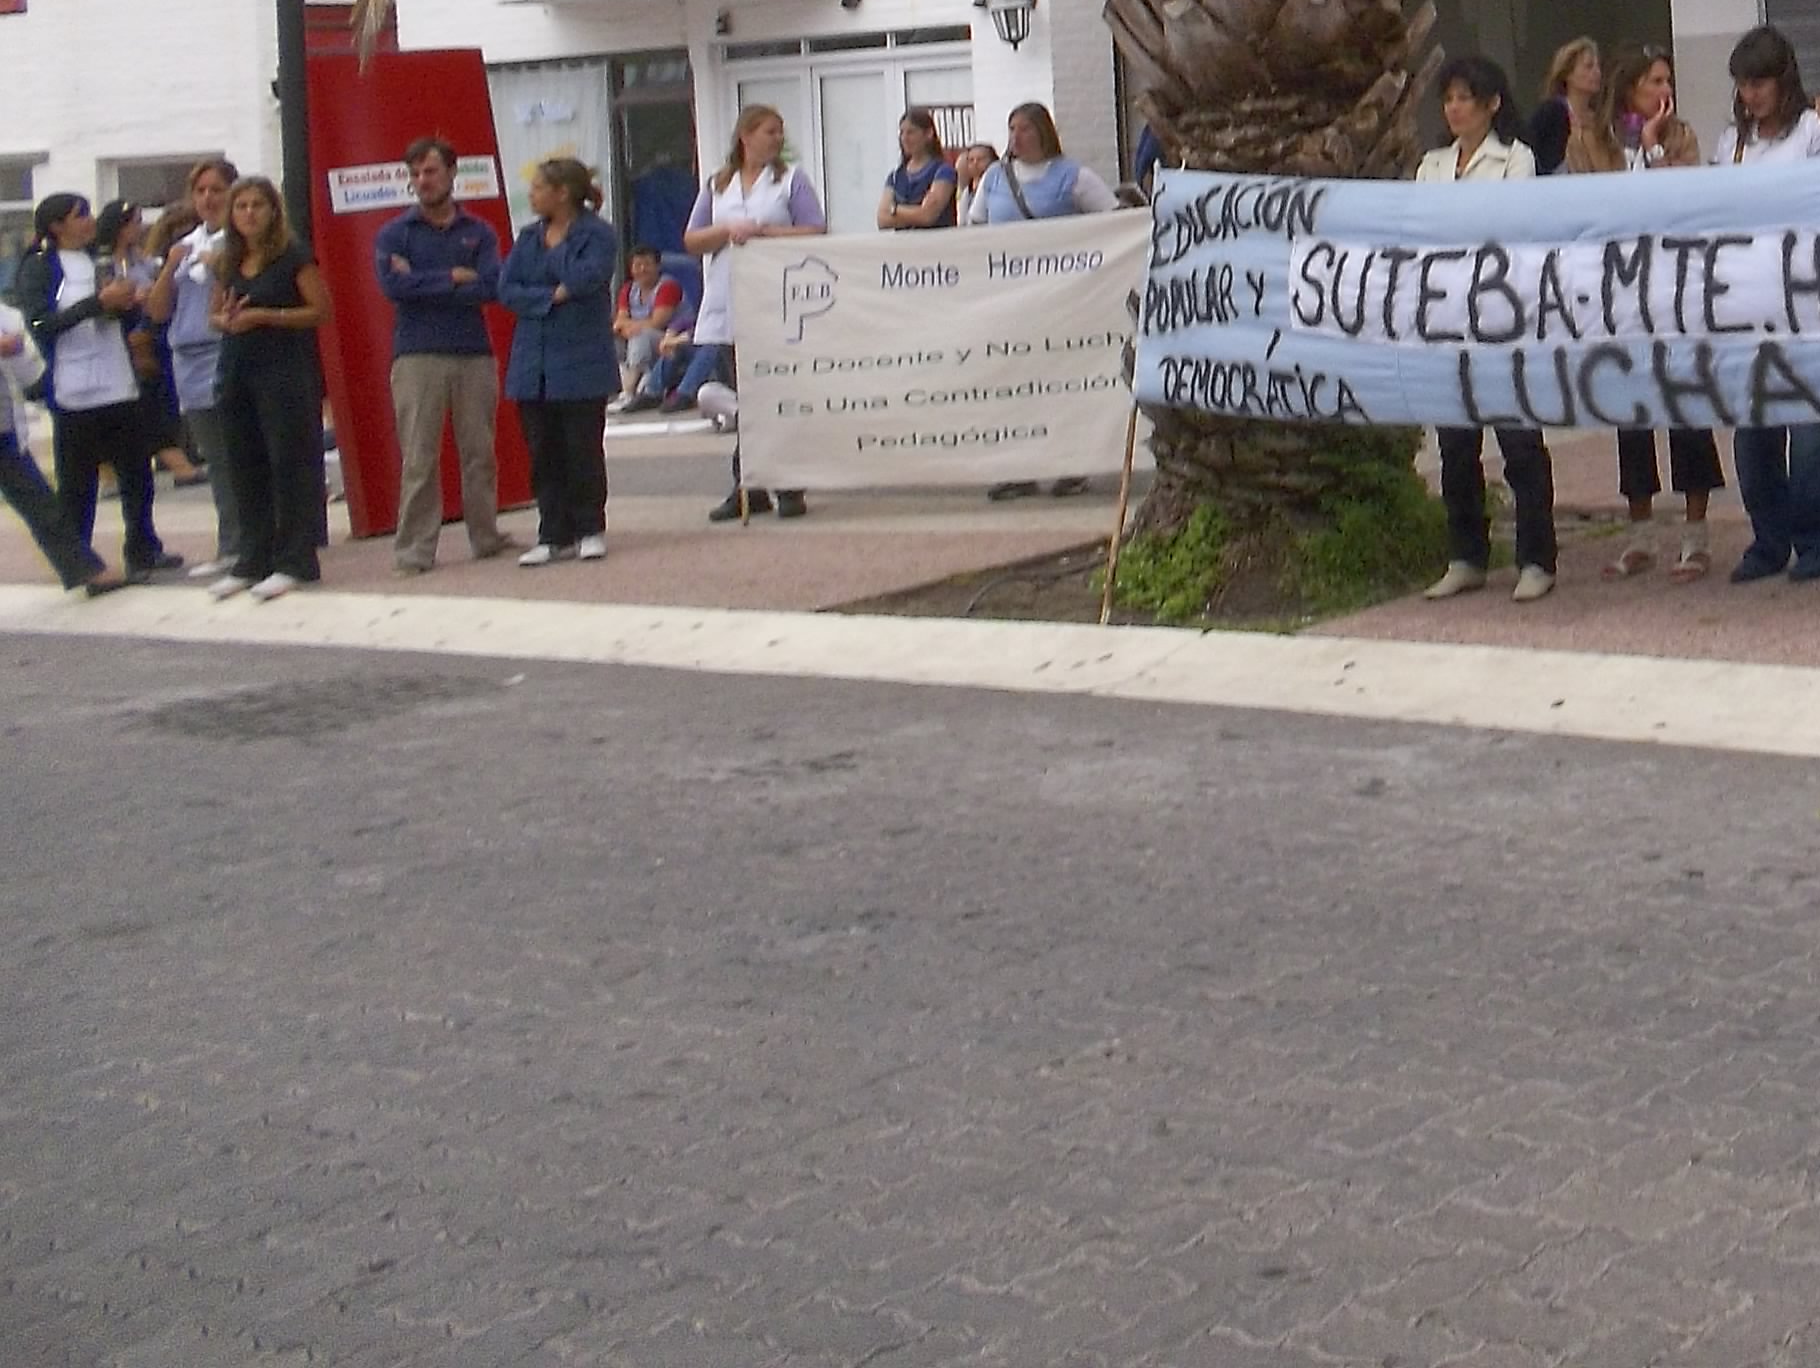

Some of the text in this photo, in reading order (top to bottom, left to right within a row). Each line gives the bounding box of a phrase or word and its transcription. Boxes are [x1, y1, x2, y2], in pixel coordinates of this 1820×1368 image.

[881, 250, 1103, 290] Monte Hermoso
[753, 359, 799, 377] Ser
[812, 350, 944, 375] Docente
[986, 340, 1032, 357] No
[778, 399, 814, 416] Es
[826, 396, 889, 413] Una
[857, 423, 1048, 452] Pedagógica
